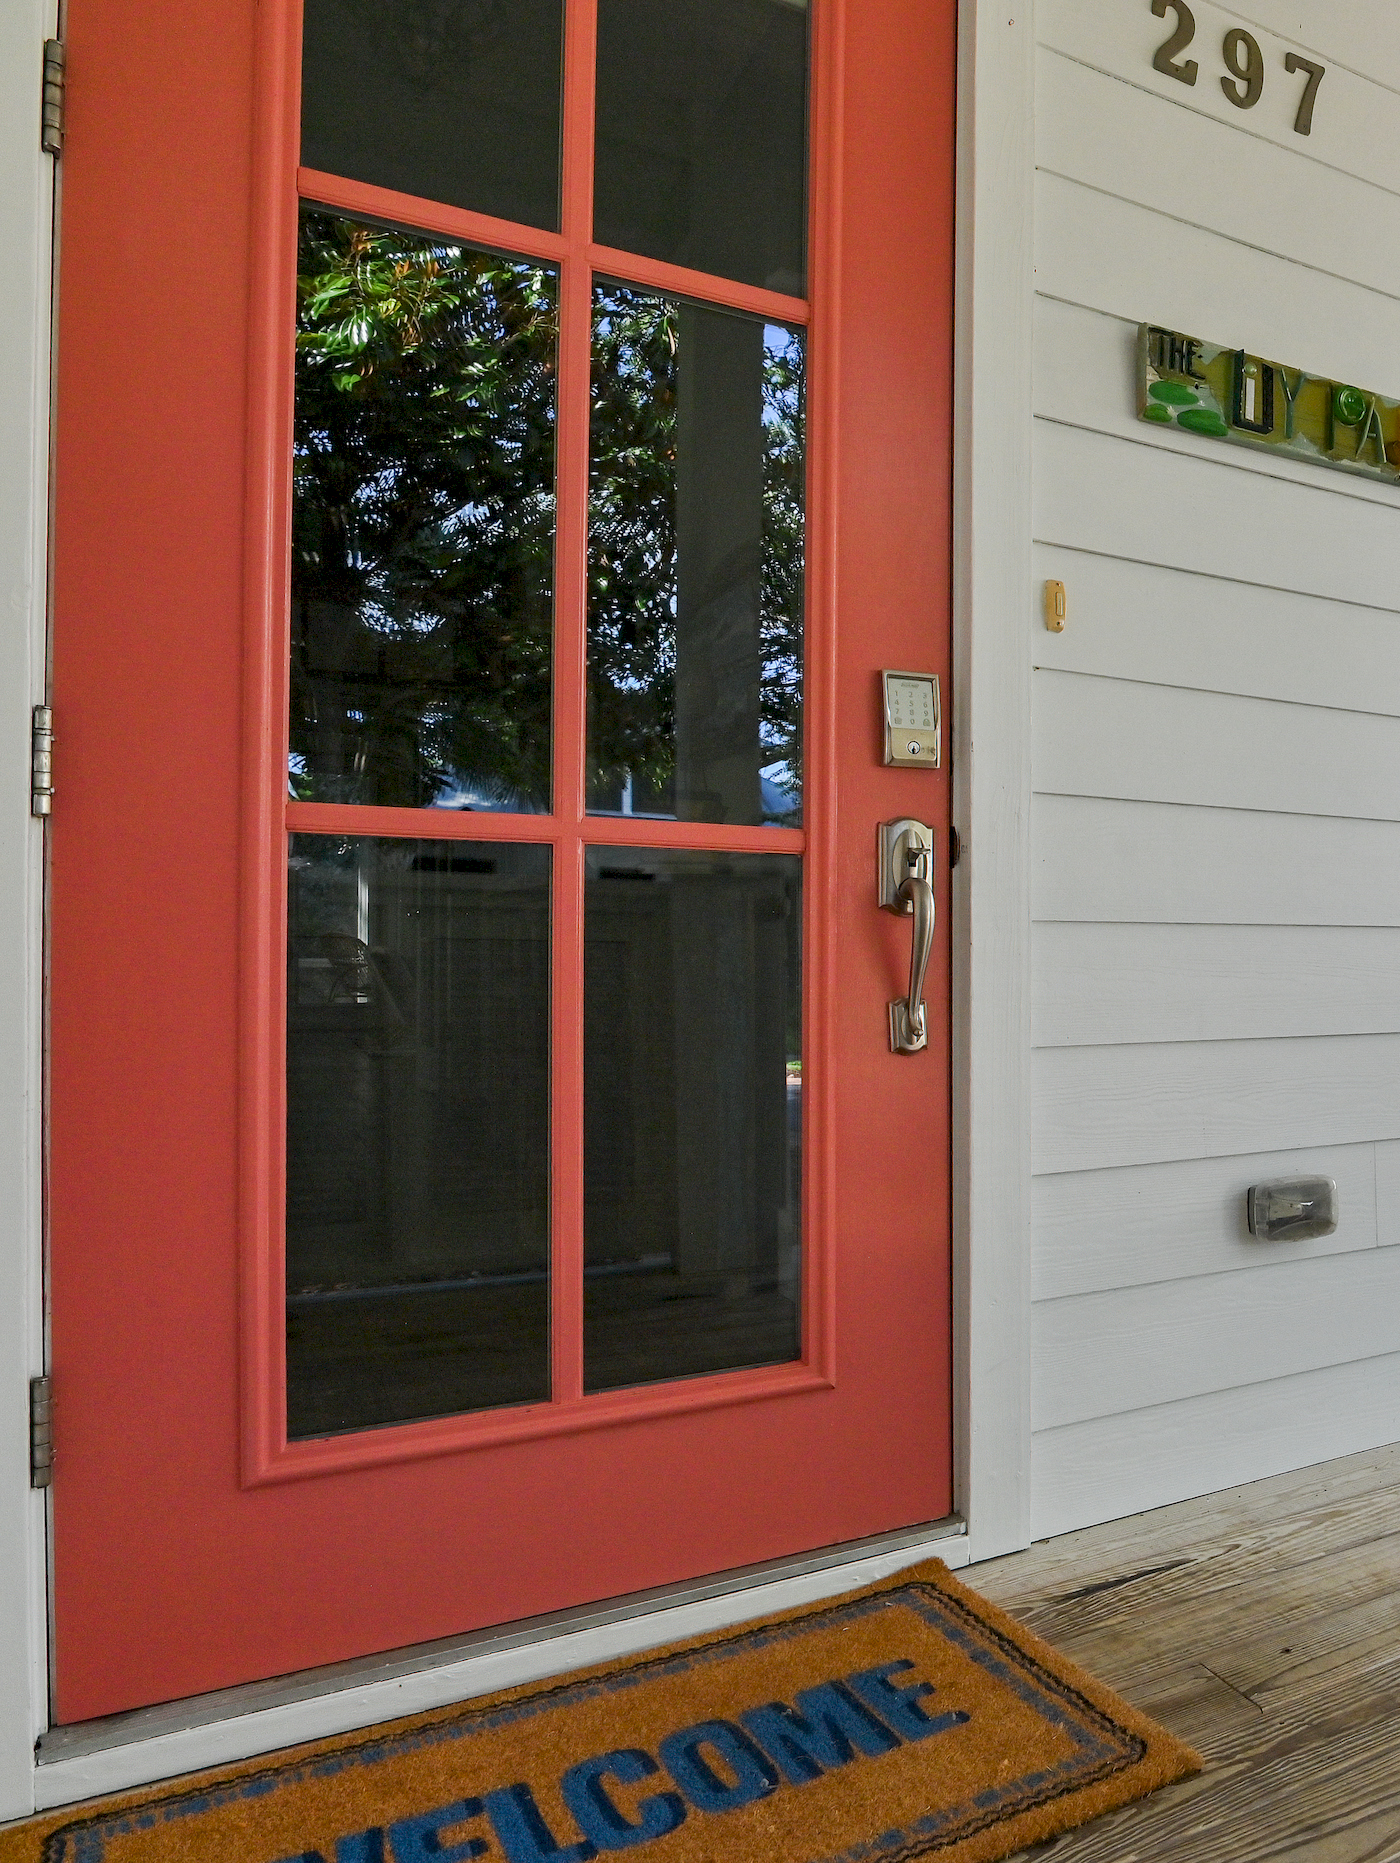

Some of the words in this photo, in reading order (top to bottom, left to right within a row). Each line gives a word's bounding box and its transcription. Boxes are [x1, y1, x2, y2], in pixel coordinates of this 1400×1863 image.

[1151, 0, 1325, 136] 297
[1147, 326, 1206, 381] THE
[262, 1658, 971, 1863] ELCOME
